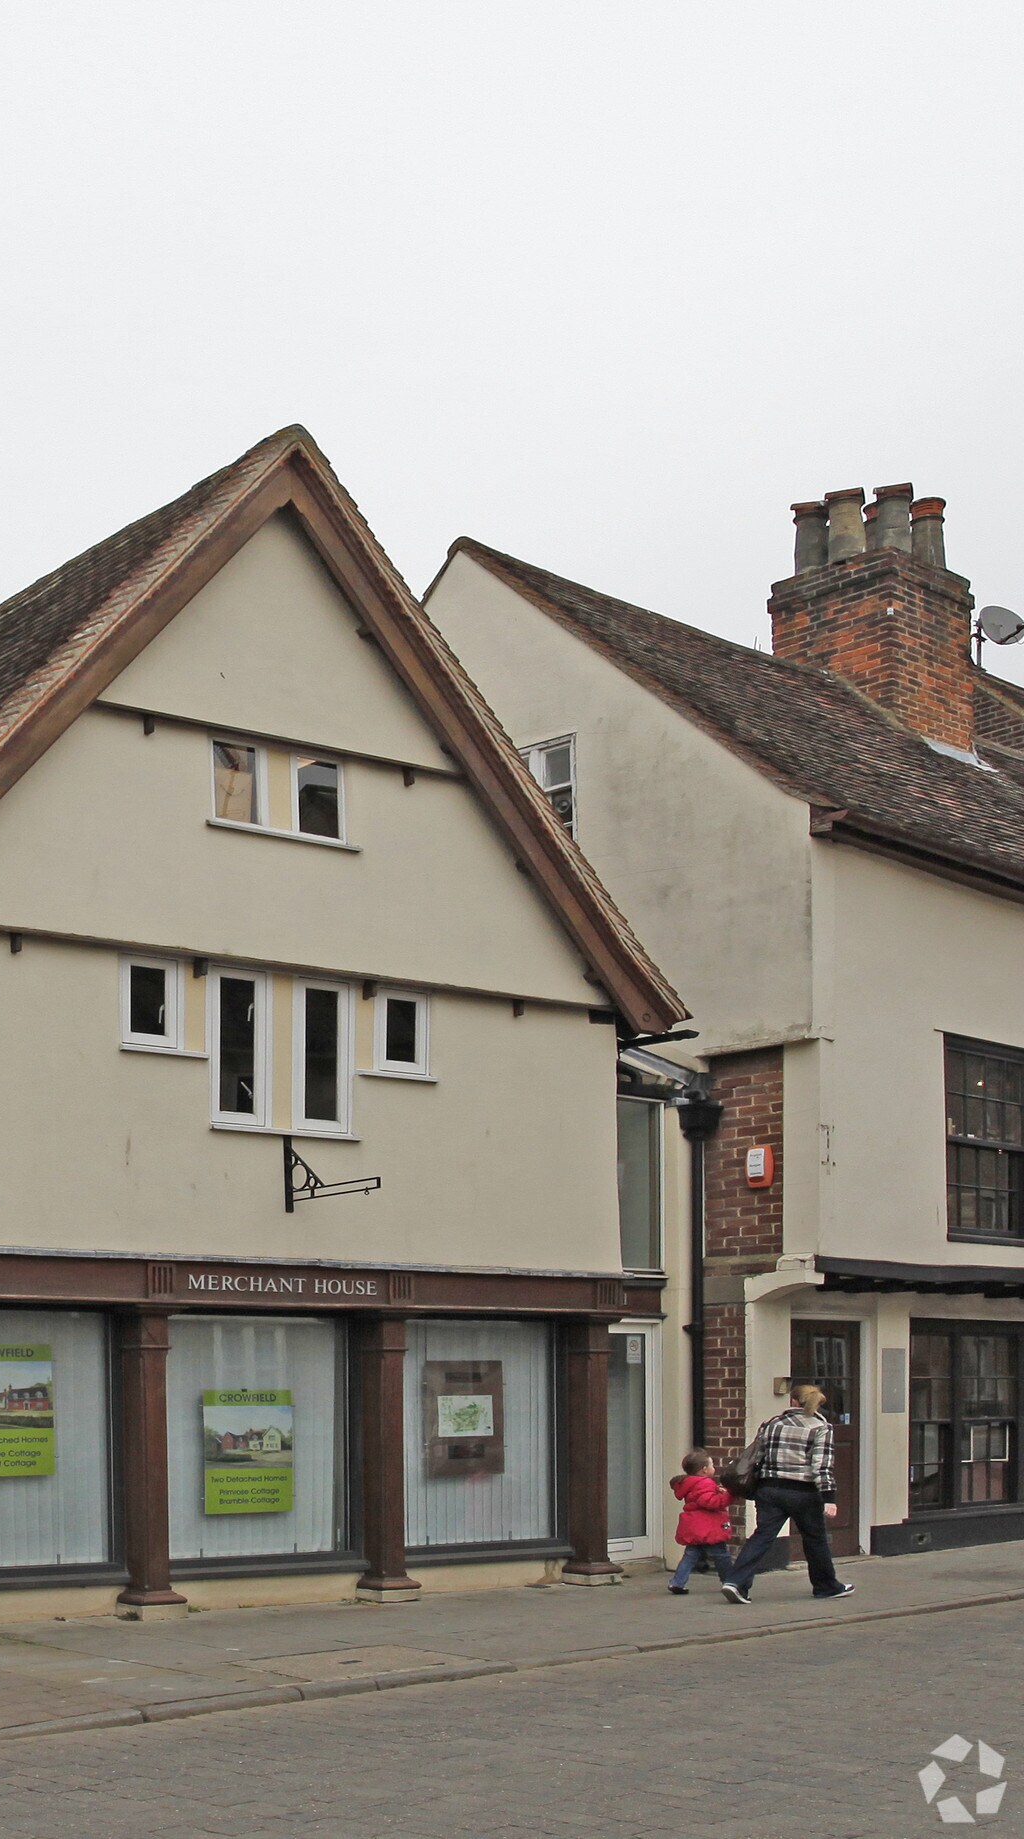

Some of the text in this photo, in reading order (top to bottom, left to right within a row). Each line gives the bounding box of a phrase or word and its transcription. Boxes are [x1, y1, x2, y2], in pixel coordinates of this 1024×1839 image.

[187, 1273, 378, 1296] MERCHANT HOUSE
[218, 1392, 277, 1403] CROWFIELD
[21, 1435, 49, 1444] Homes
[8, 1449, 42, 1459] Cottage
[3, 1459, 37, 1468] Cottage
[211, 1474, 288, 1484] Two Detached Homes
[219, 1487, 280, 1496] Primrose Cottage
[219, 1496, 280, 1505] Bramble Cottage
